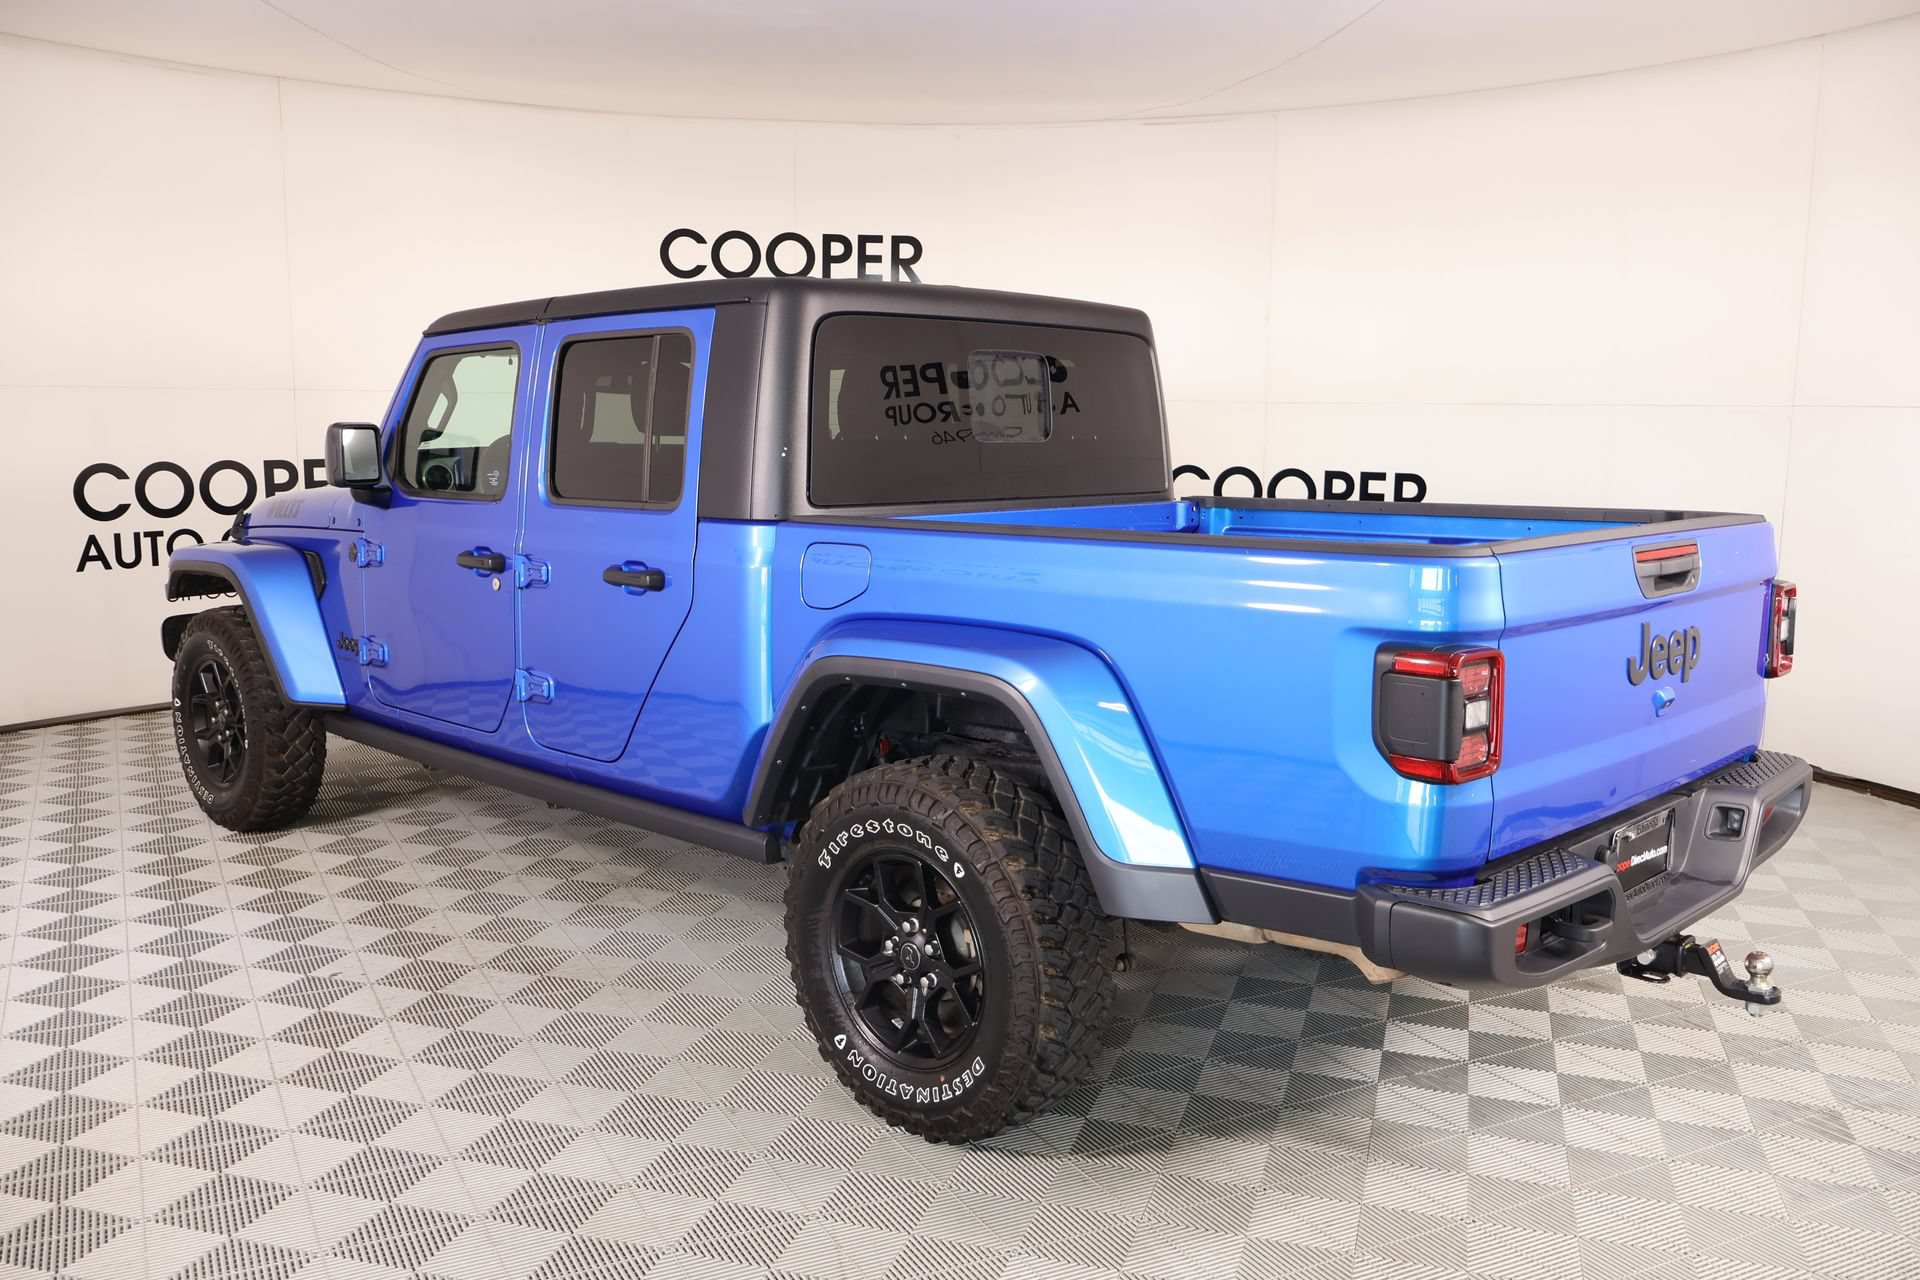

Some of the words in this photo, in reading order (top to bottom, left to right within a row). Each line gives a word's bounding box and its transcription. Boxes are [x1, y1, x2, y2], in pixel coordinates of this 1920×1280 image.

[659, 228, 923, 284] COOPER
[73, 459, 328, 522] COOPE
[1626, 622, 1701, 687] Jeep
[817, 818, 949, 869] Firestone
[847, 1050, 986, 1104] DESTINATION
